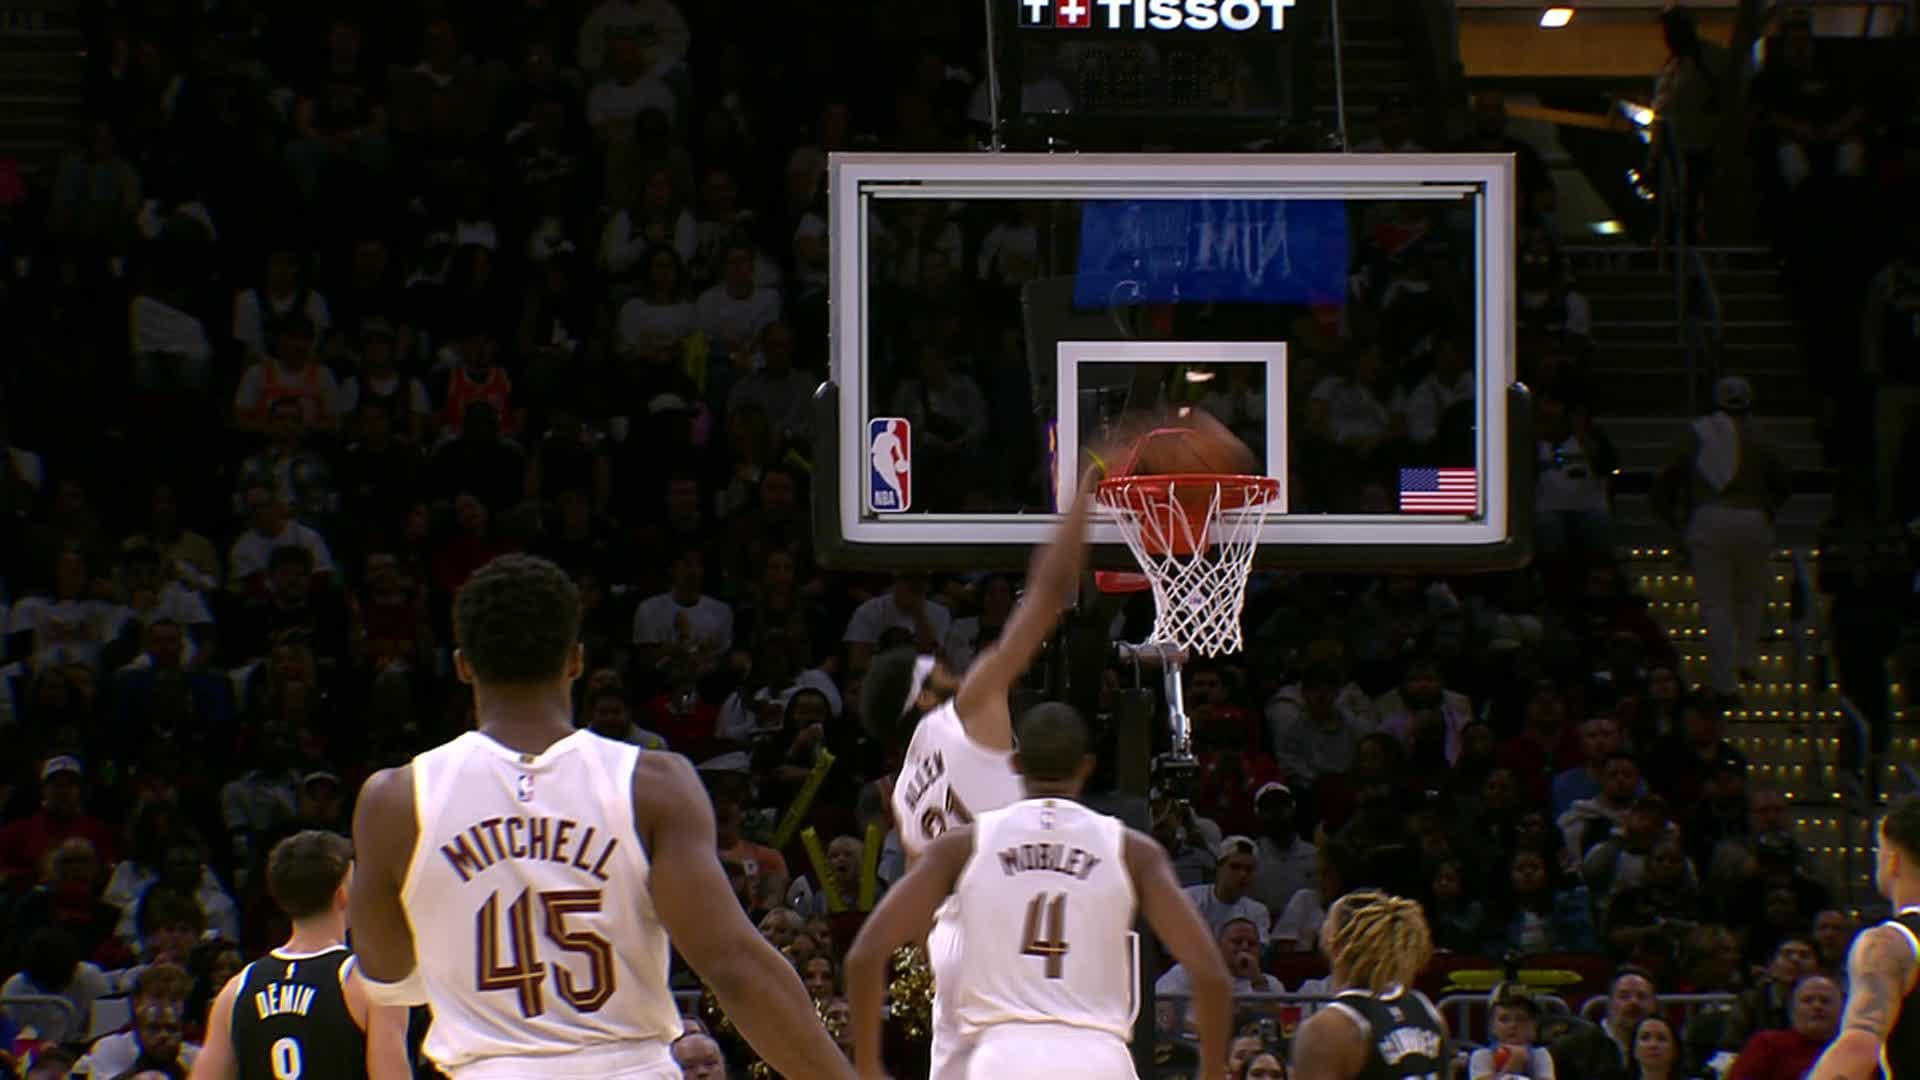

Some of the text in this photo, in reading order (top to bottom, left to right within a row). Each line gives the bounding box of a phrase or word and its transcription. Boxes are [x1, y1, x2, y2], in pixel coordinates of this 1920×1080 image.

[1097, 0, 1297, 32] TISSOT
[905, 749, 945, 815] ALLEN
[441, 816, 619, 882] MITCHELL
[997, 843, 1102, 880] MOBLEY
[476, 885, 616, 1018] 45
[1020, 891, 1069, 979] 4
